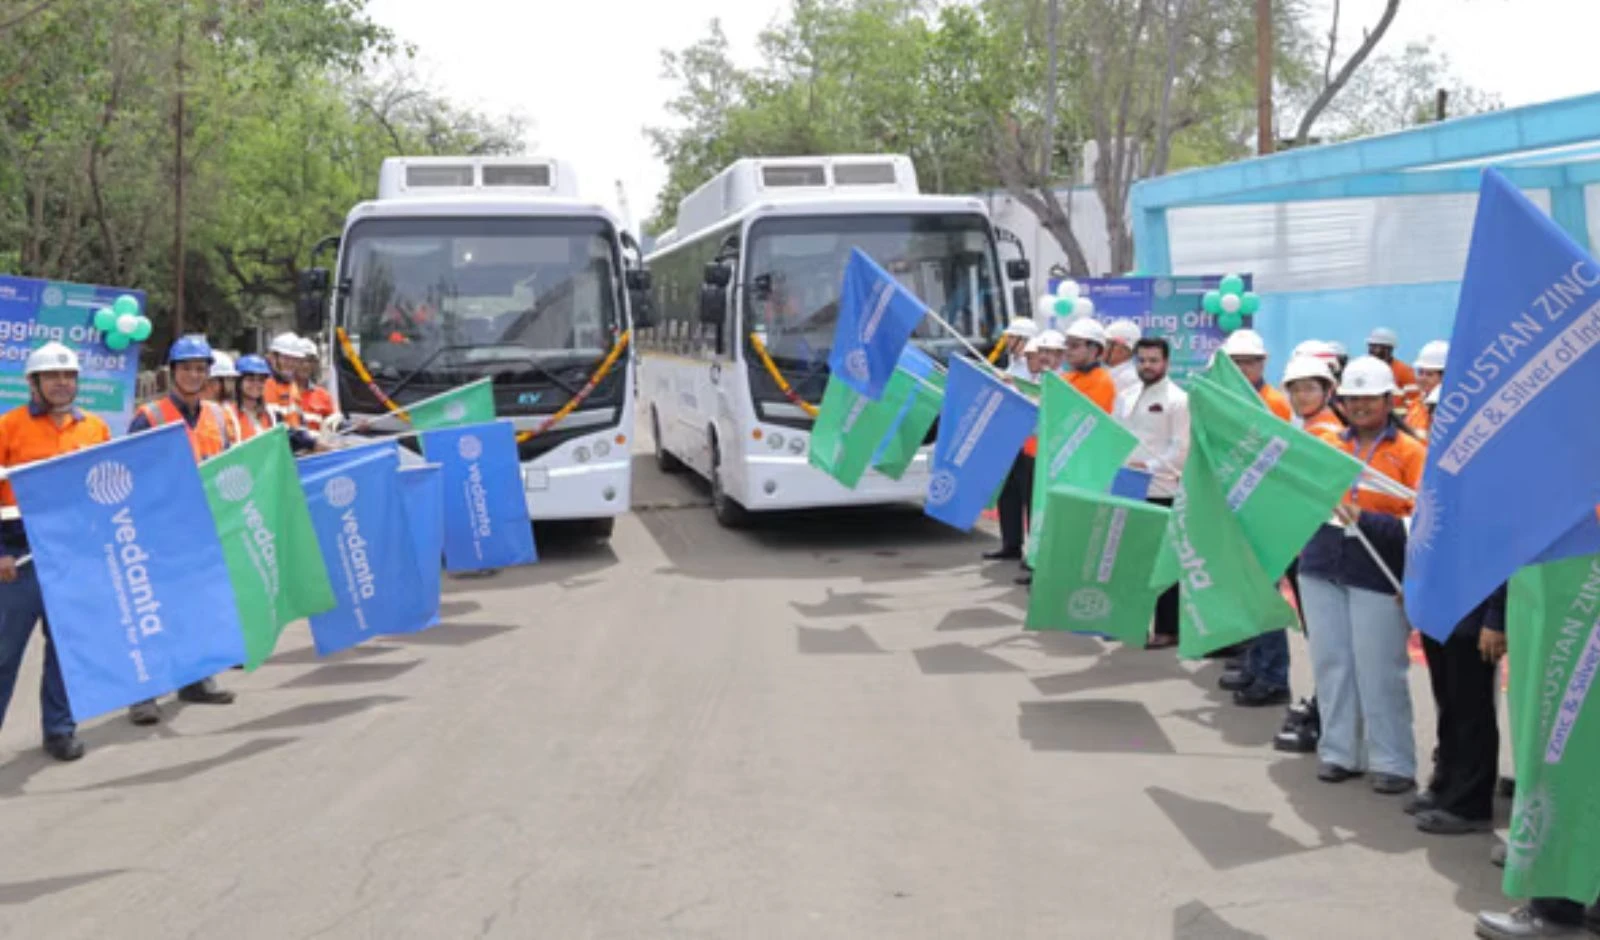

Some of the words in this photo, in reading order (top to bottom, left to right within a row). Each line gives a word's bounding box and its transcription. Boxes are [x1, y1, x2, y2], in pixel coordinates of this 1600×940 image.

[1531, 261, 1600, 320] ZINC
[1447, 423, 1489, 464] Zinc
[1501, 360, 1555, 409] Silver
[1555, 338, 1578, 362] of
[1571, 305, 1600, 346] Ind
[111, 505, 164, 637] vedanta
[340, 507, 375, 600] vedanta
